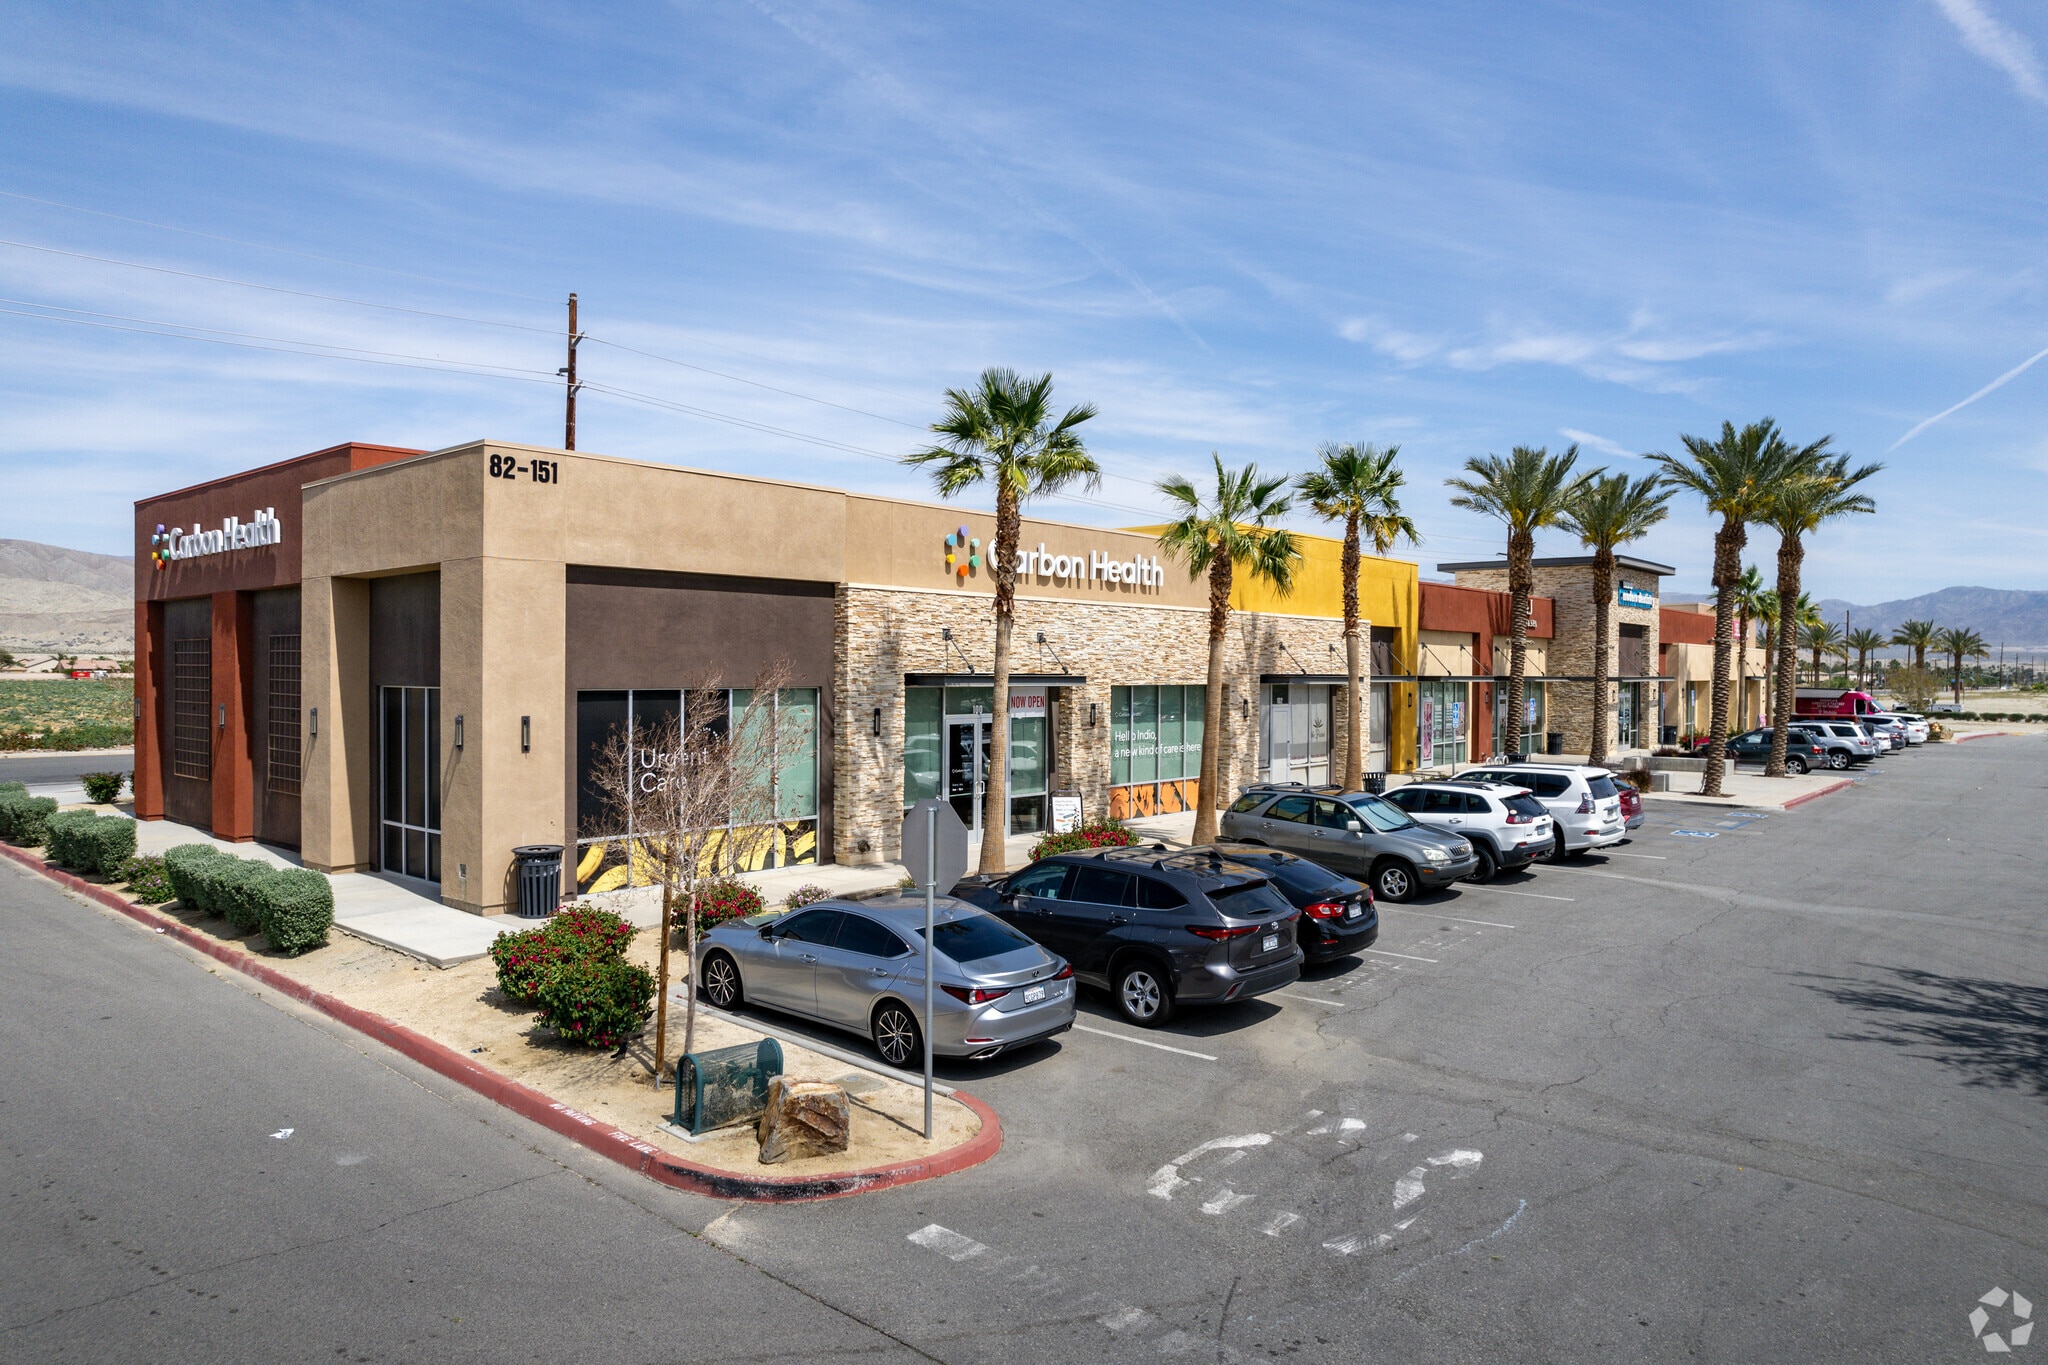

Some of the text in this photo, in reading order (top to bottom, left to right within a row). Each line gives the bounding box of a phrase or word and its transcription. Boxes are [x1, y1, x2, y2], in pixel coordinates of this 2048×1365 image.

[489, 454, 558, 485] 82-151
[169, 507, 281, 560] Carbon Health
[1089, 549, 1164, 587] Health
[1011, 696, 1045, 708] NOW OPEN
[1115, 729, 1157, 742] Hello Indio,
[1115, 749, 1119, 758] a
[1121, 747, 1138, 757] new
[1138, 744, 1154, 756] kind
[1155, 744, 1163, 755] of
[1164, 744, 1178, 754] care
[1186, 742, 1201, 752] here
[640, 772, 687, 793] Care
[560, 1108, 597, 1126] PARKING
[608, 1131, 659, 1154] FIRE LANE
